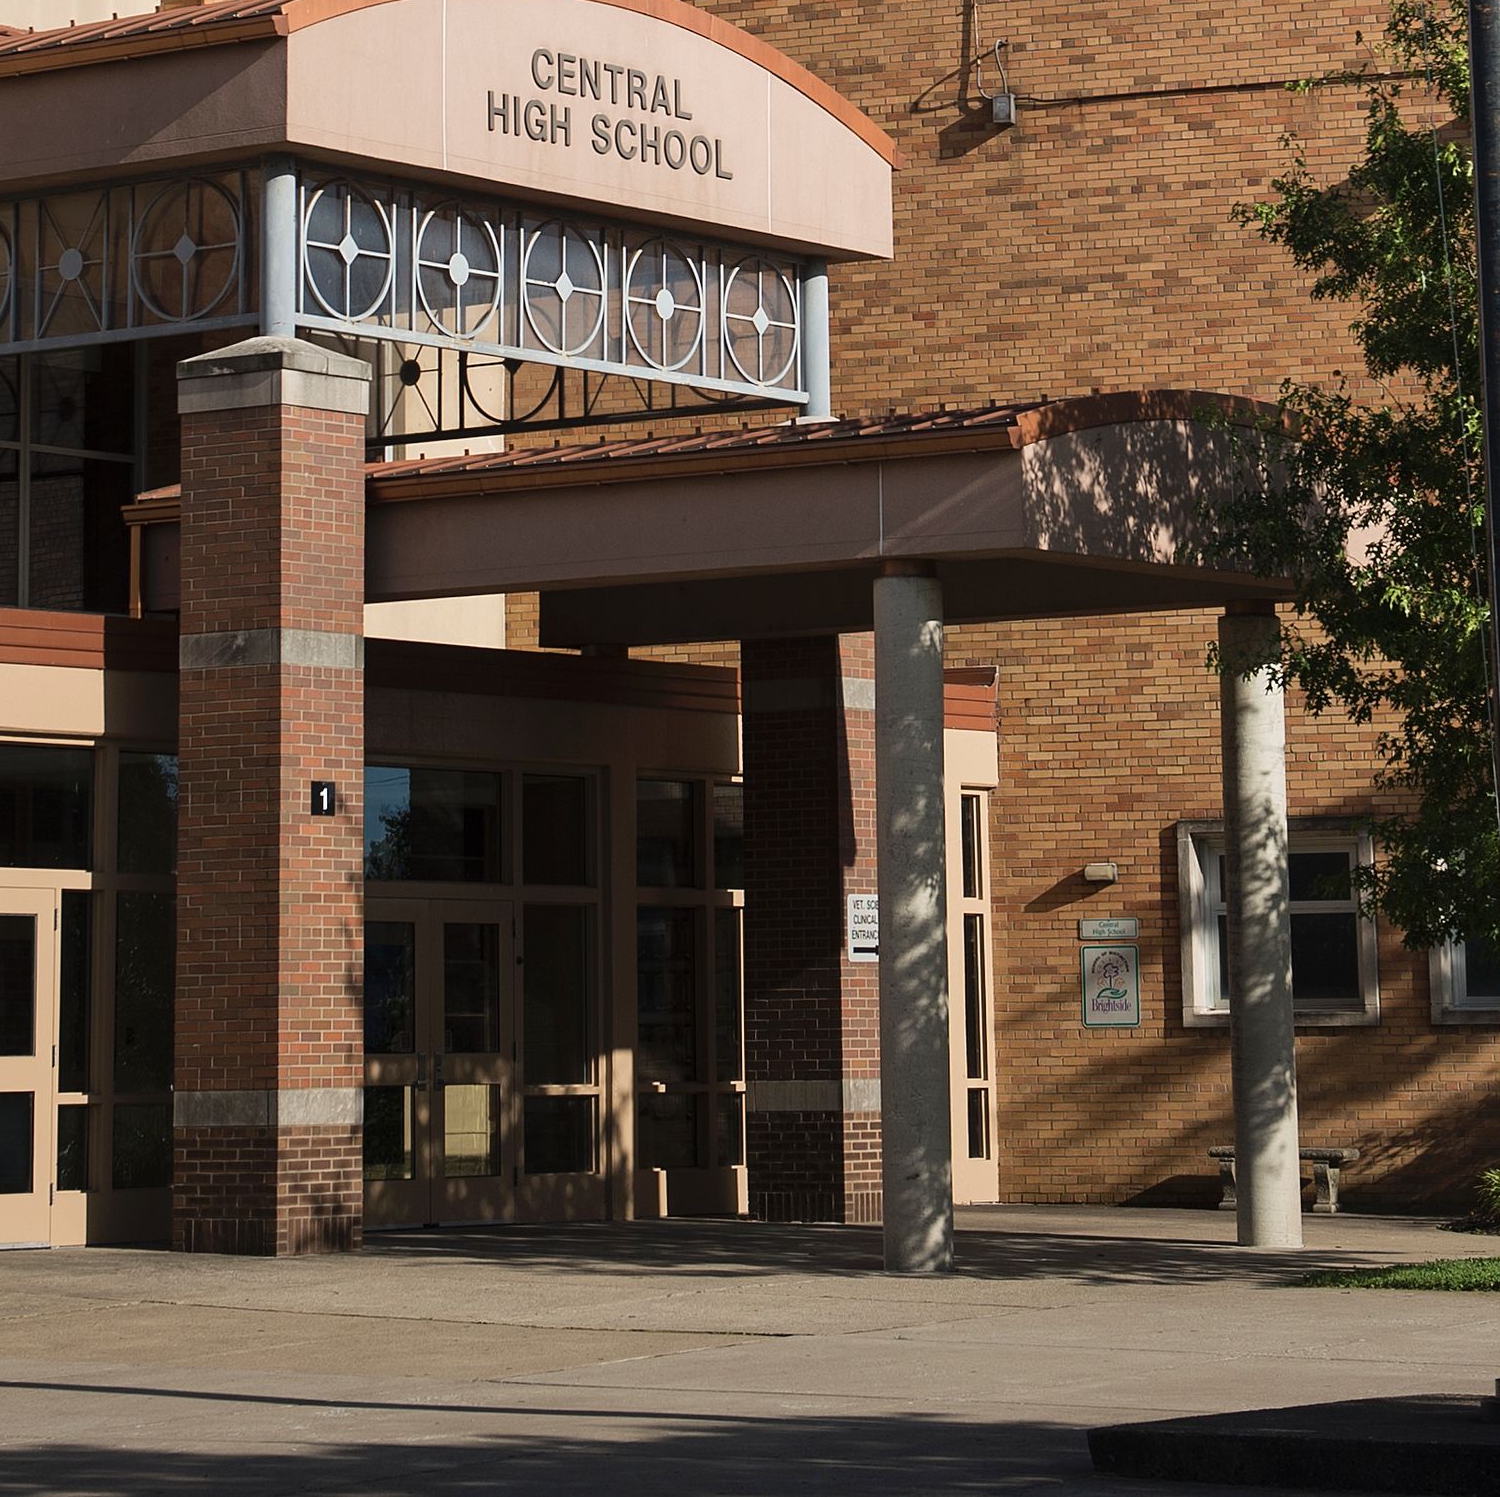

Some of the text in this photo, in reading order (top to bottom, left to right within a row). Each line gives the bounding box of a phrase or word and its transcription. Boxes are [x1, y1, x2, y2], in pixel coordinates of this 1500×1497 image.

[531, 47, 693, 121] CENTRAL
[487, 90, 734, 180] HIGH SCHOOL
[319, 787, 329, 811] 1
[866, 899, 879, 910] SCIE
[853, 914, 878, 925] CLINICAL
[851, 929, 878, 940] ENTRANC
[1107, 927, 1126, 935] School
[1091, 998, 1132, 1014] Brightside
